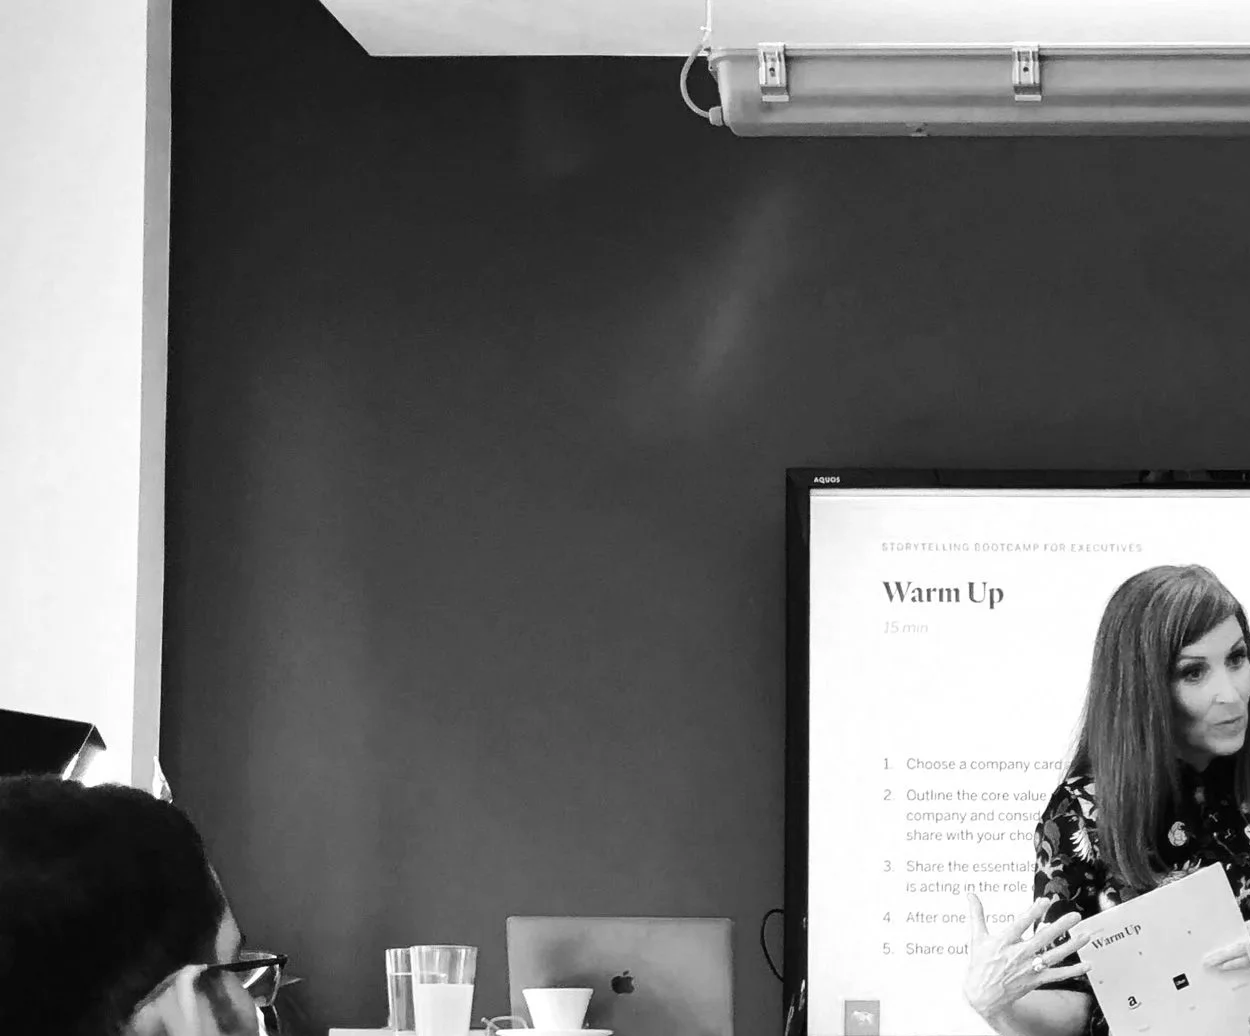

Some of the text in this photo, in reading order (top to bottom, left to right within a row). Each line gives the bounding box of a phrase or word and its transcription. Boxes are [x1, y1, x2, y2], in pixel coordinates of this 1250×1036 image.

[813, 476, 841, 484] AQUOS
[881, 542, 1143, 553] STORYTELLING BOOTCAMP FOR EXECUTIVES
[883, 581, 1004, 610] Warm Up
[883, 621, 929, 634] 15 min
[906, 757, 956, 770] Choose
[959, 760, 967, 770] a
[970, 760, 1031, 773] company
[1033, 759, 1063, 770] card
[906, 788, 953, 801] Outline
[956, 789, 978, 801] the
[981, 791, 1010, 801] core
[1013, 789, 1047, 801] value
[906, 811, 967, 824] company
[970, 811, 995, 822] and
[906, 830, 943, 841] share
[946, 829, 974, 841] with
[977, 831, 1006, 844] your
[906, 860, 945, 873] Share
[948, 861, 969, 873] the
[972, 860, 1036, 873] essentials
[906, 882, 917, 893] is
[919, 881, 961, 896] acting
[964, 881, 976, 893] in
[978, 881, 1000, 893] the
[1003, 880, 1028, 893] role
[906, 911, 938, 924] After
[942, 913, 967, 924] one
[1091, 924, 1142, 950] Warm Up
[906, 942, 945, 956] Share
[947, 944, 969, 956] out
